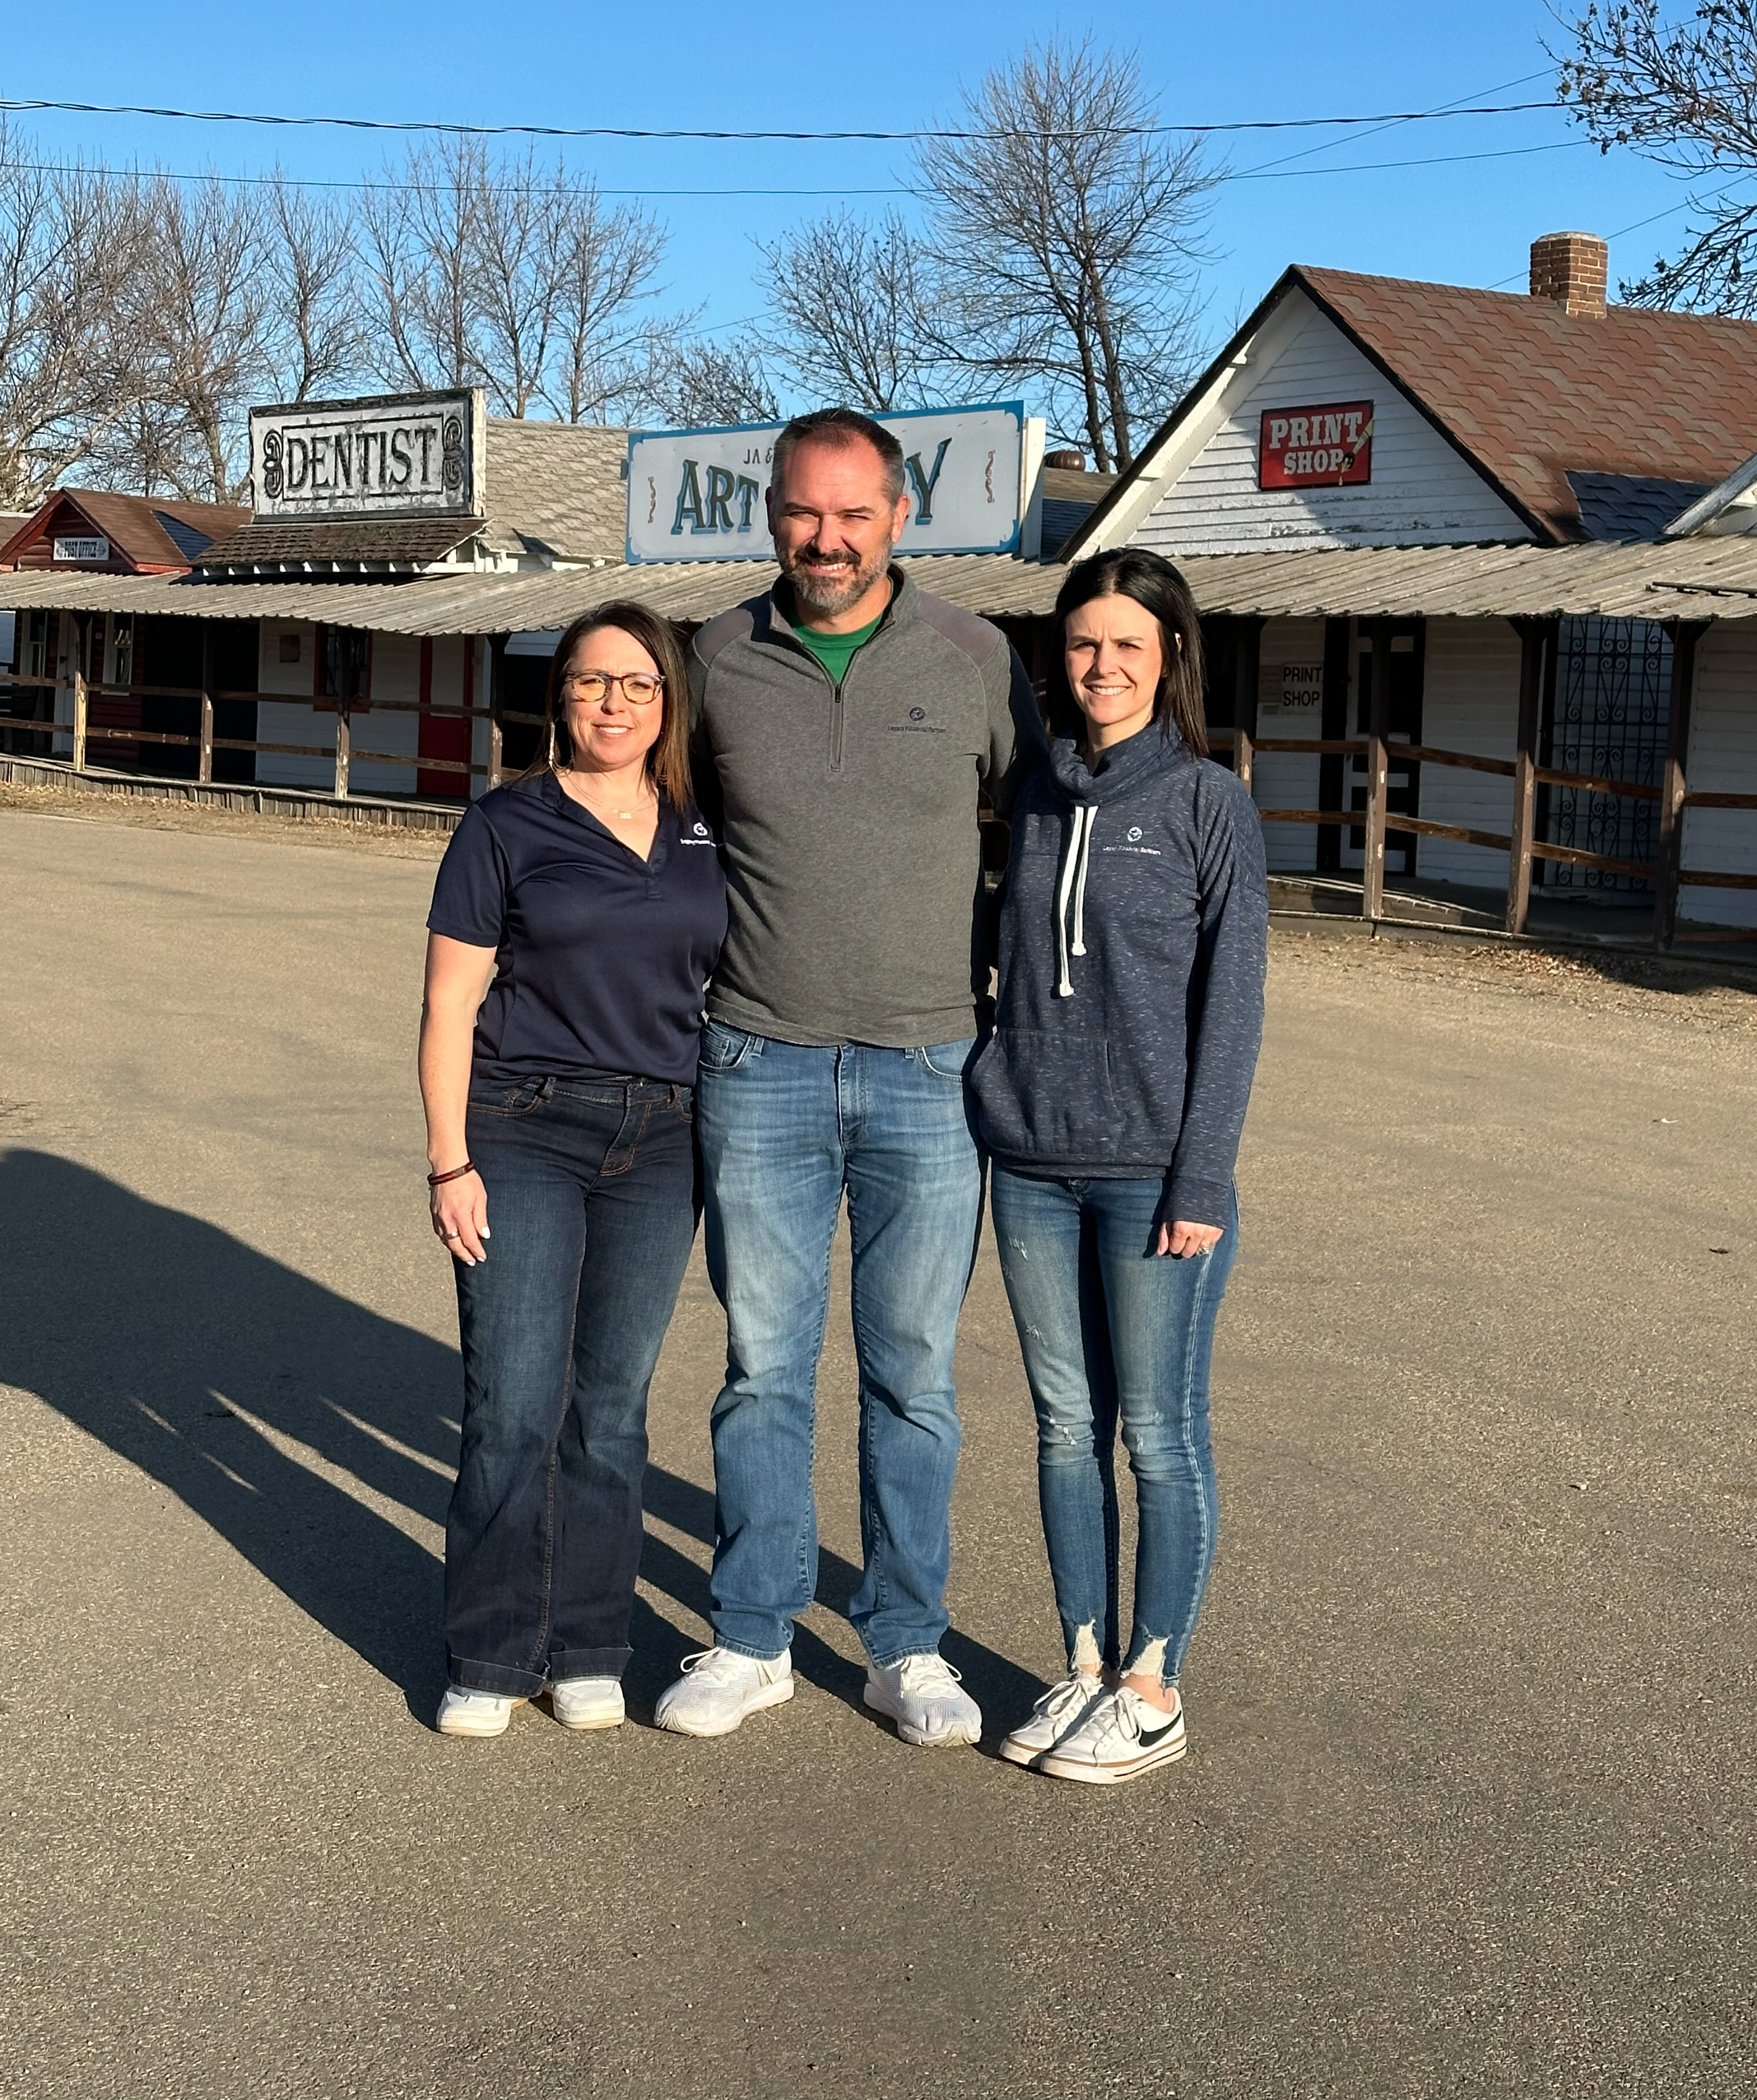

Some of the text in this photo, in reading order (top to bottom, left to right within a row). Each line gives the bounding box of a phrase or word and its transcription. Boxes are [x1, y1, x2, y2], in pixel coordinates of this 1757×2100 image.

[1269, 411, 1363, 449] PRINT
[287, 428, 438, 490] DENTIST
[1283, 449, 1345, 475] SHOP
[1283, 666, 1322, 683] PRINT
[1283, 690, 1320, 707] SHOP
